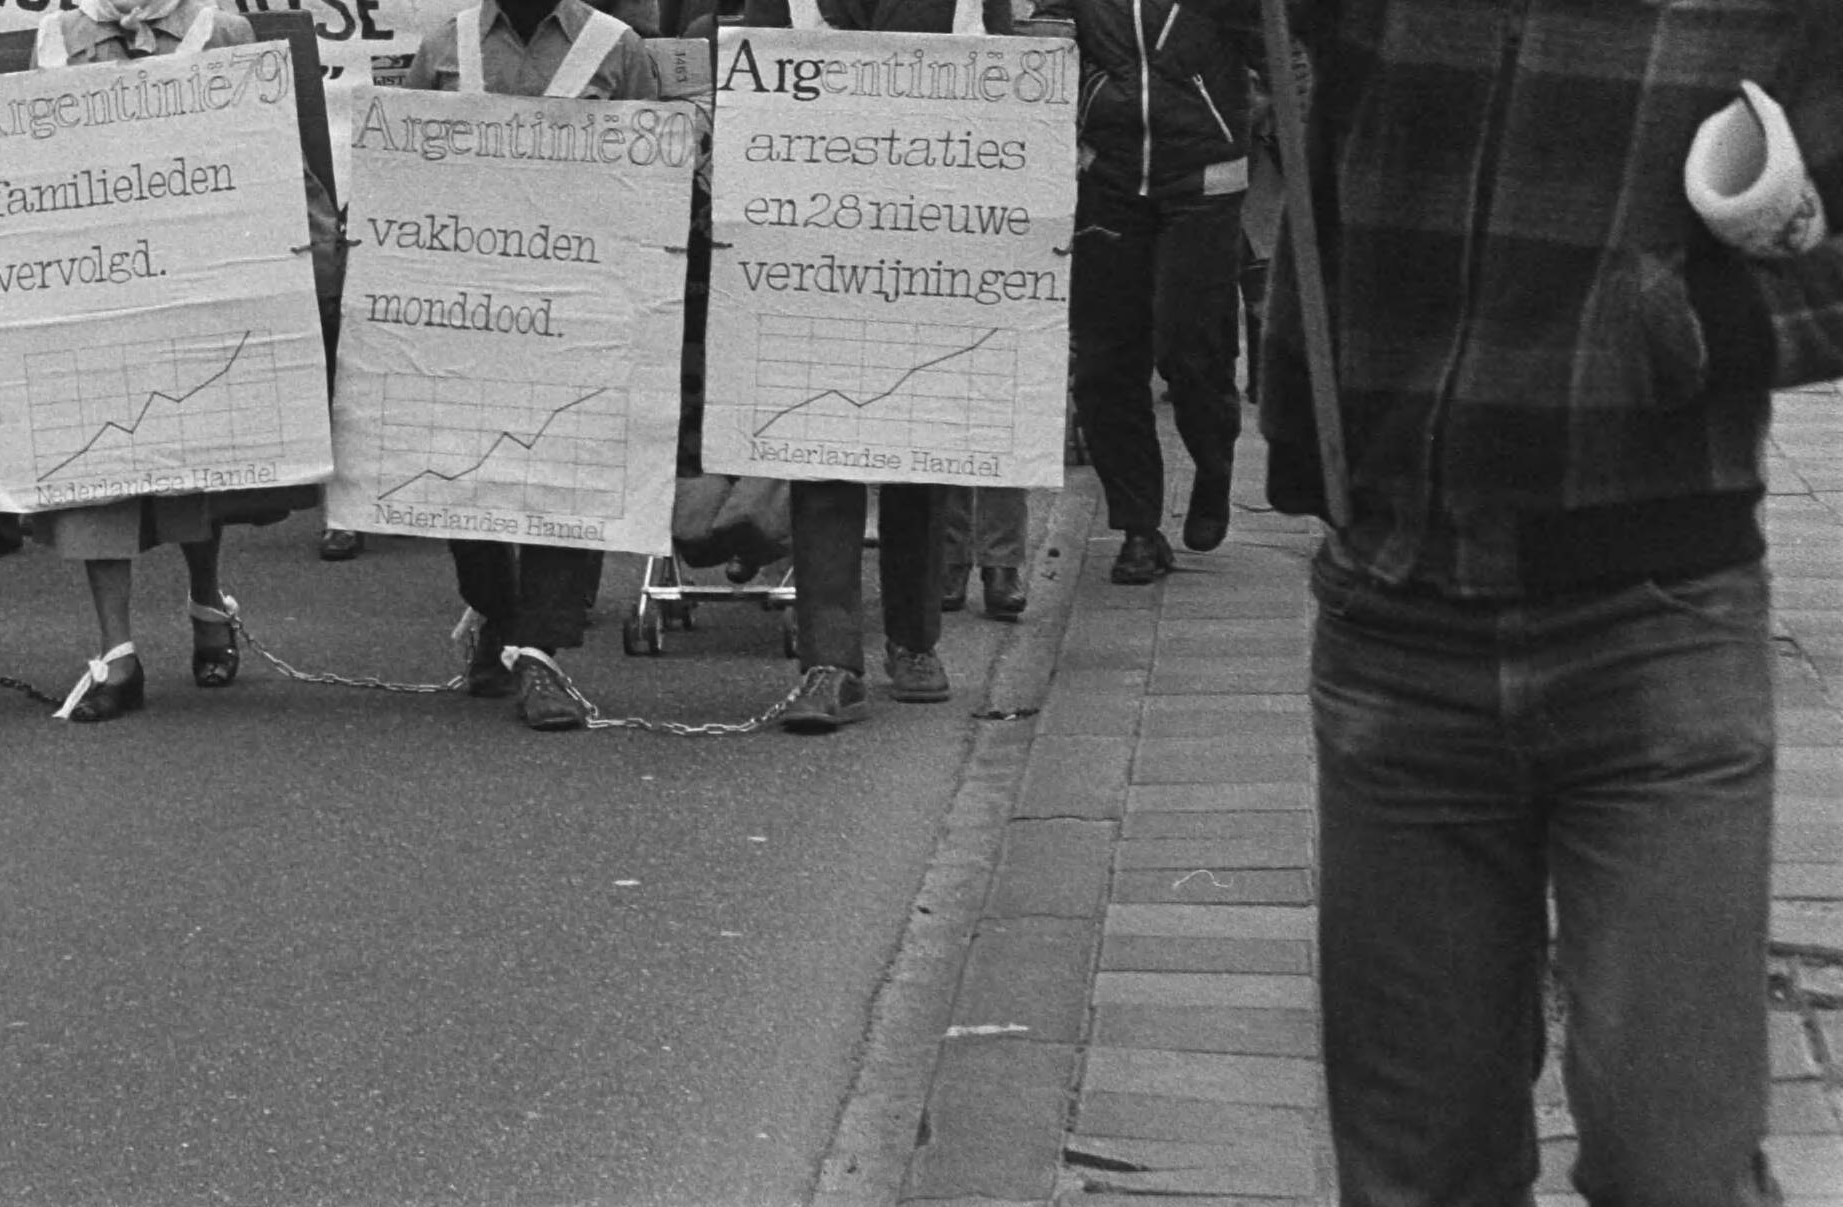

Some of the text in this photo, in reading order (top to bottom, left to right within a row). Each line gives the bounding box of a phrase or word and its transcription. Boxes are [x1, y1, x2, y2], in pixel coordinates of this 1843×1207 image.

[744, 126, 1027, 172] arrestaties
[744, 191, 1030, 237] en 28 nieuwe
[367, 211, 600, 265] vakbonden
[740, 253, 1067, 306] verdwijningen.
[365, 290, 563, 338] monddood.
[190, 463, 278, 489] Handel
[749, 439, 1002, 478] Nederlandse Handel
[372, 502, 607, 543] Nederlandse Handel
